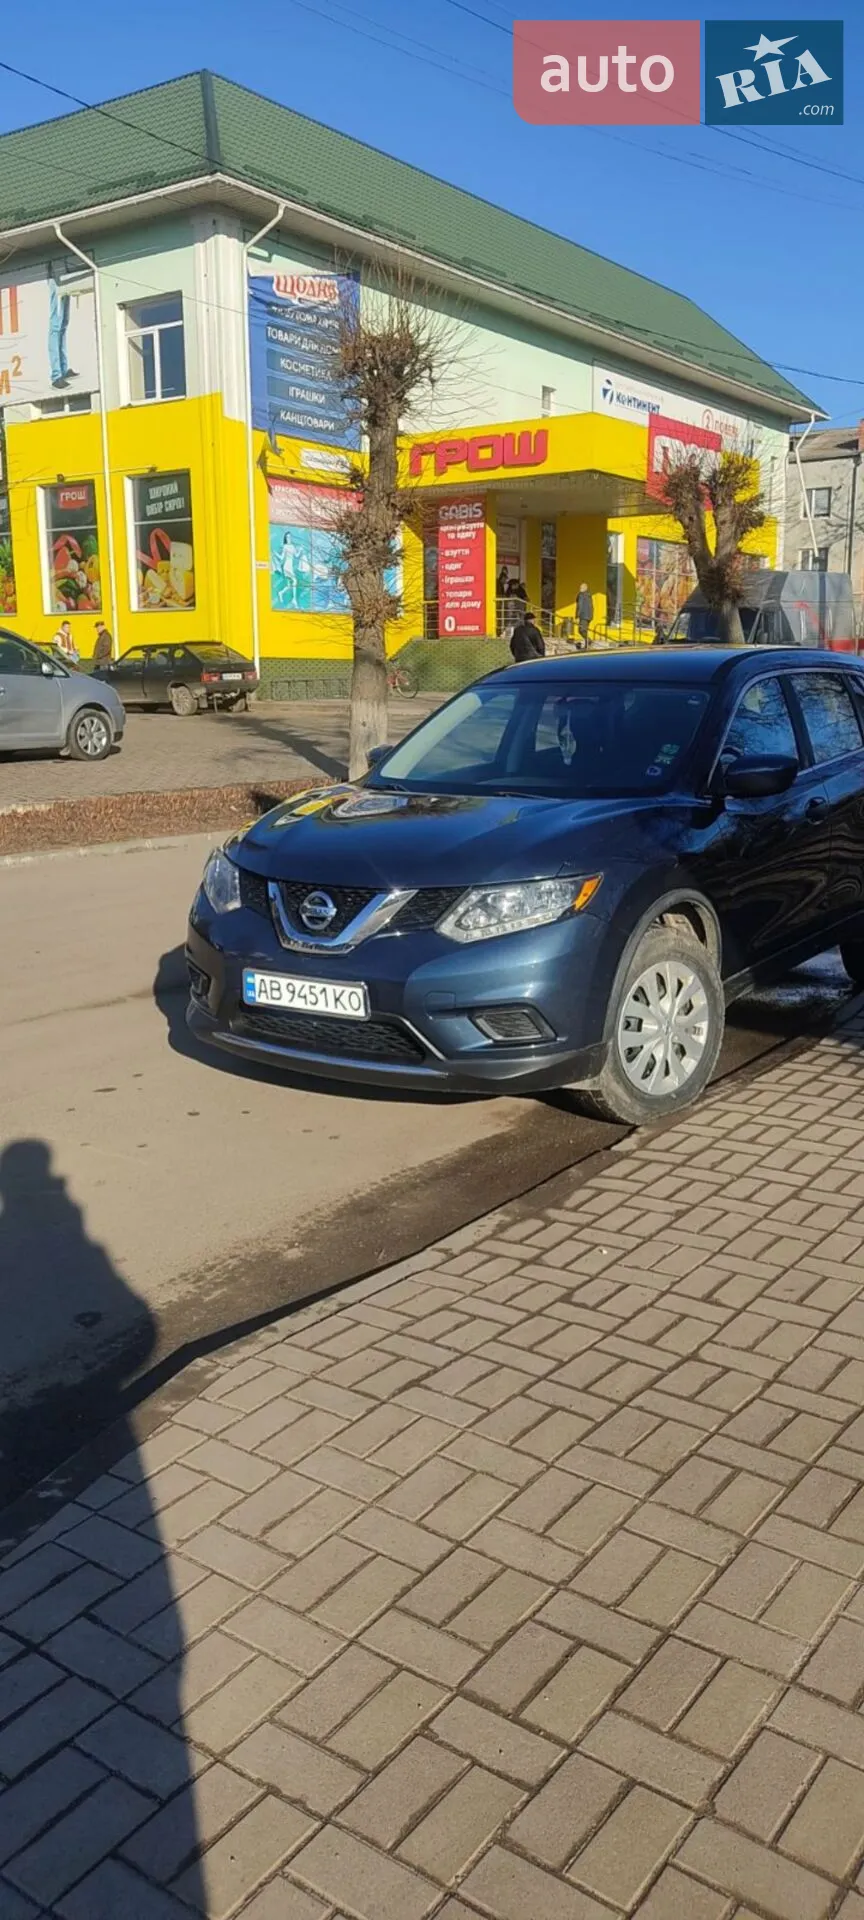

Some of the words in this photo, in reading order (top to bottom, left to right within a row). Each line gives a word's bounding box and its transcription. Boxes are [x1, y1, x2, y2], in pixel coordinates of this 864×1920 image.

[267, 326, 301, 346] ТОВАРИ
[280, 357, 333, 381] КОСМЕТИКА
[288, 386, 325, 404] ІГРАШКИ
[280, 409, 335, 431] КАНЦТОВАРИ
[409, 429, 549, 477] ГРОШ
[59, 488, 87, 501] ГРОШ
